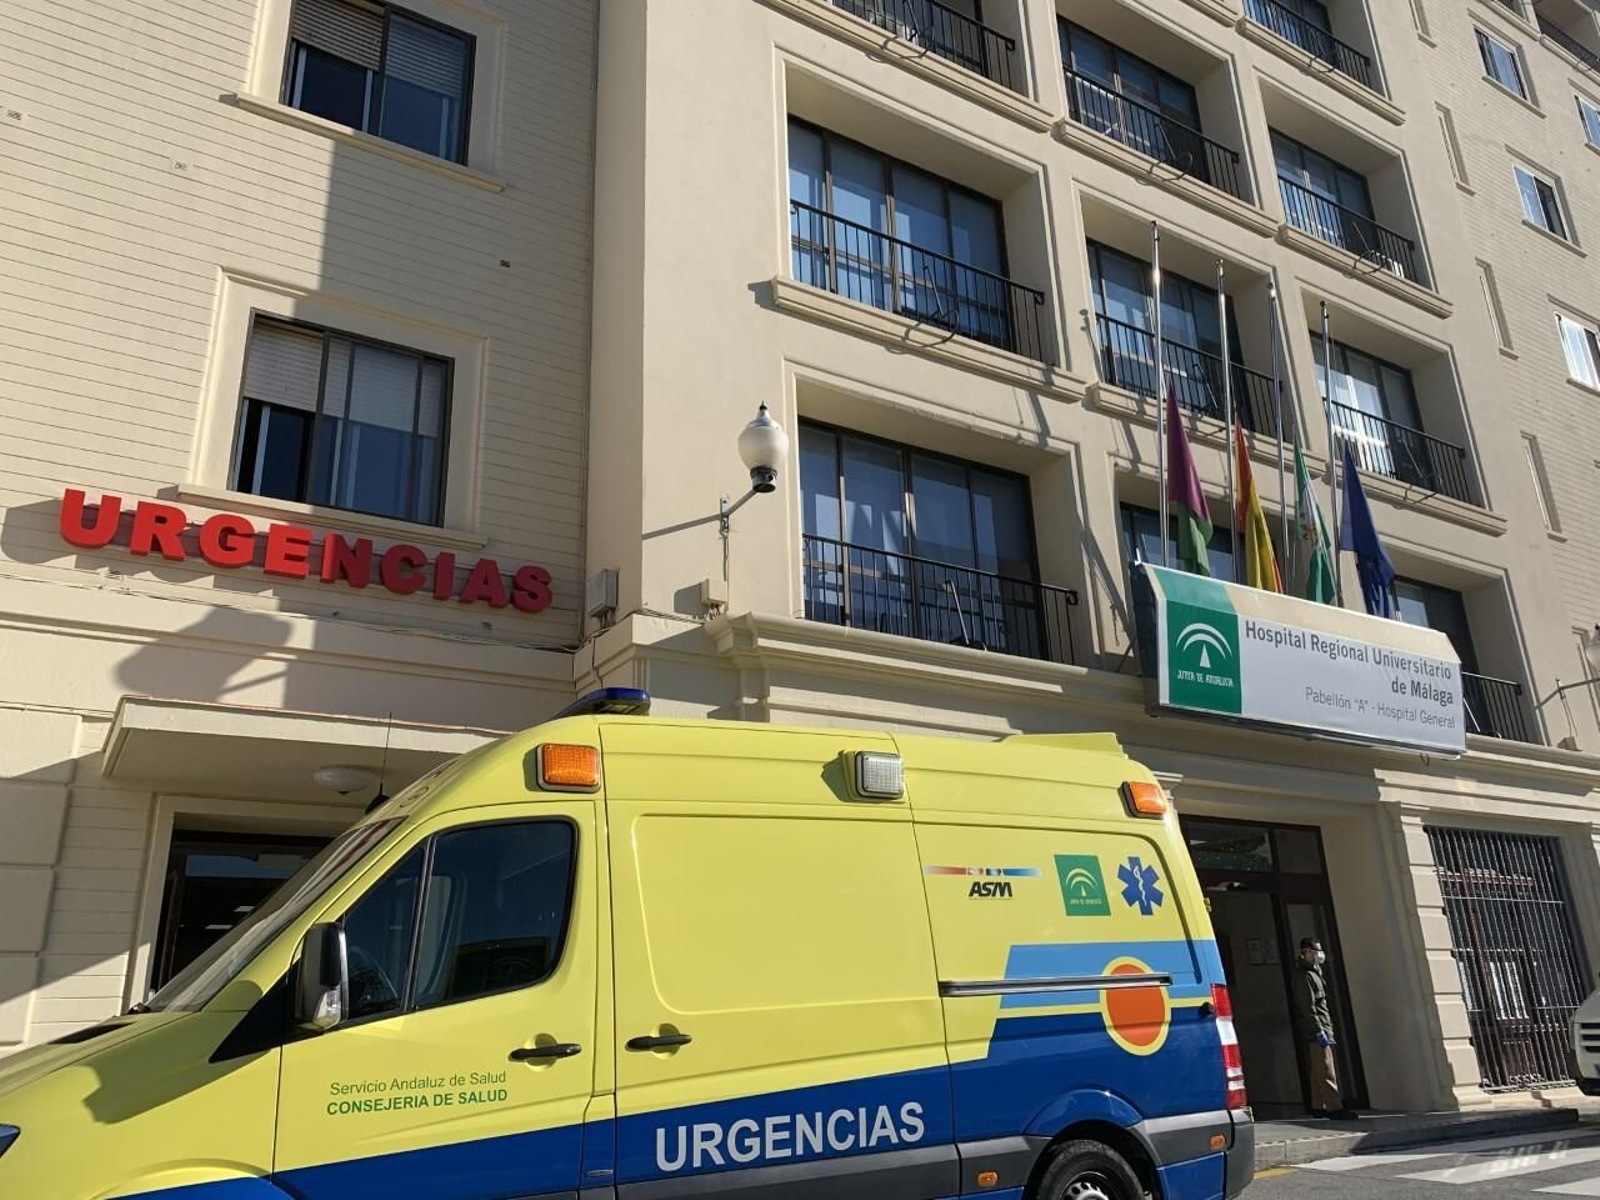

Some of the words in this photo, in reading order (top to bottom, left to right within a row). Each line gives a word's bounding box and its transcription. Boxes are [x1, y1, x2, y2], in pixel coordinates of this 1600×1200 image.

[60, 488, 553, 613] URGENCIAS
[1245, 620, 1306, 650] Hospital
[1310, 634, 1369, 663] Regional
[1372, 647, 1452, 680] Universitario
[1305, 686, 1351, 710] Pabellón
[1354, 699, 1369, 713] "A"
[1378, 702, 1417, 722] Hospital
[1420, 709, 1456, 729] General
[1391, 676, 1407, 695] de
[1411, 680, 1454, 707] Málaga
[968, 881, 1013, 897] ASM
[330, 1080, 387, 1096] Servicio
[390, 1075, 446, 1091] Andaluz
[449, 1074, 466, 1087] de
[470, 1070, 507, 1085] Salud
[327, 1095, 430, 1116] CONSEJERIA
[433, 1093, 454, 1107] DE
[458, 1089, 508, 1105] SALUD
[656, 1102, 925, 1172] URGENCIAS
